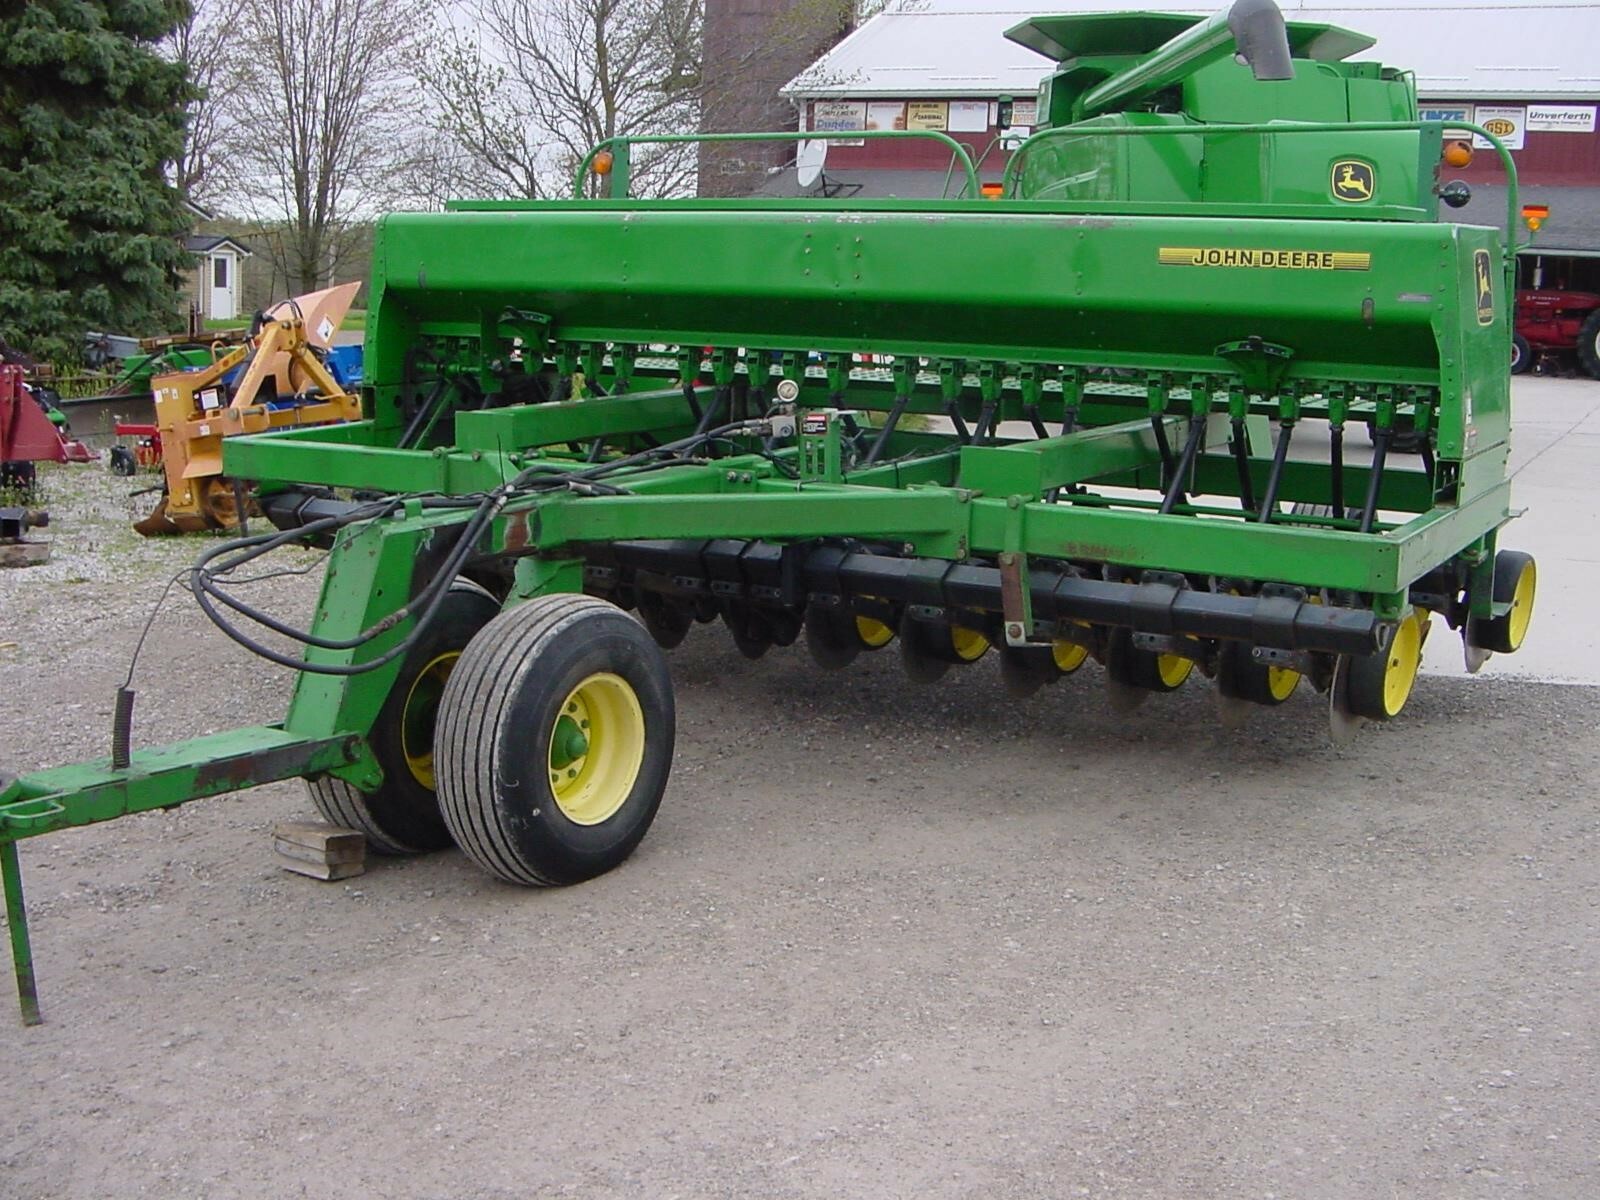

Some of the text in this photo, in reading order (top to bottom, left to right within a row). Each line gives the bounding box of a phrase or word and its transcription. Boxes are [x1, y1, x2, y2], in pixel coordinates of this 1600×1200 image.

[1529, 111, 1592, 121] Unverferth
[1486, 121, 1510, 134] GSI
[1193, 249, 1334, 268] JOHN DEERE
